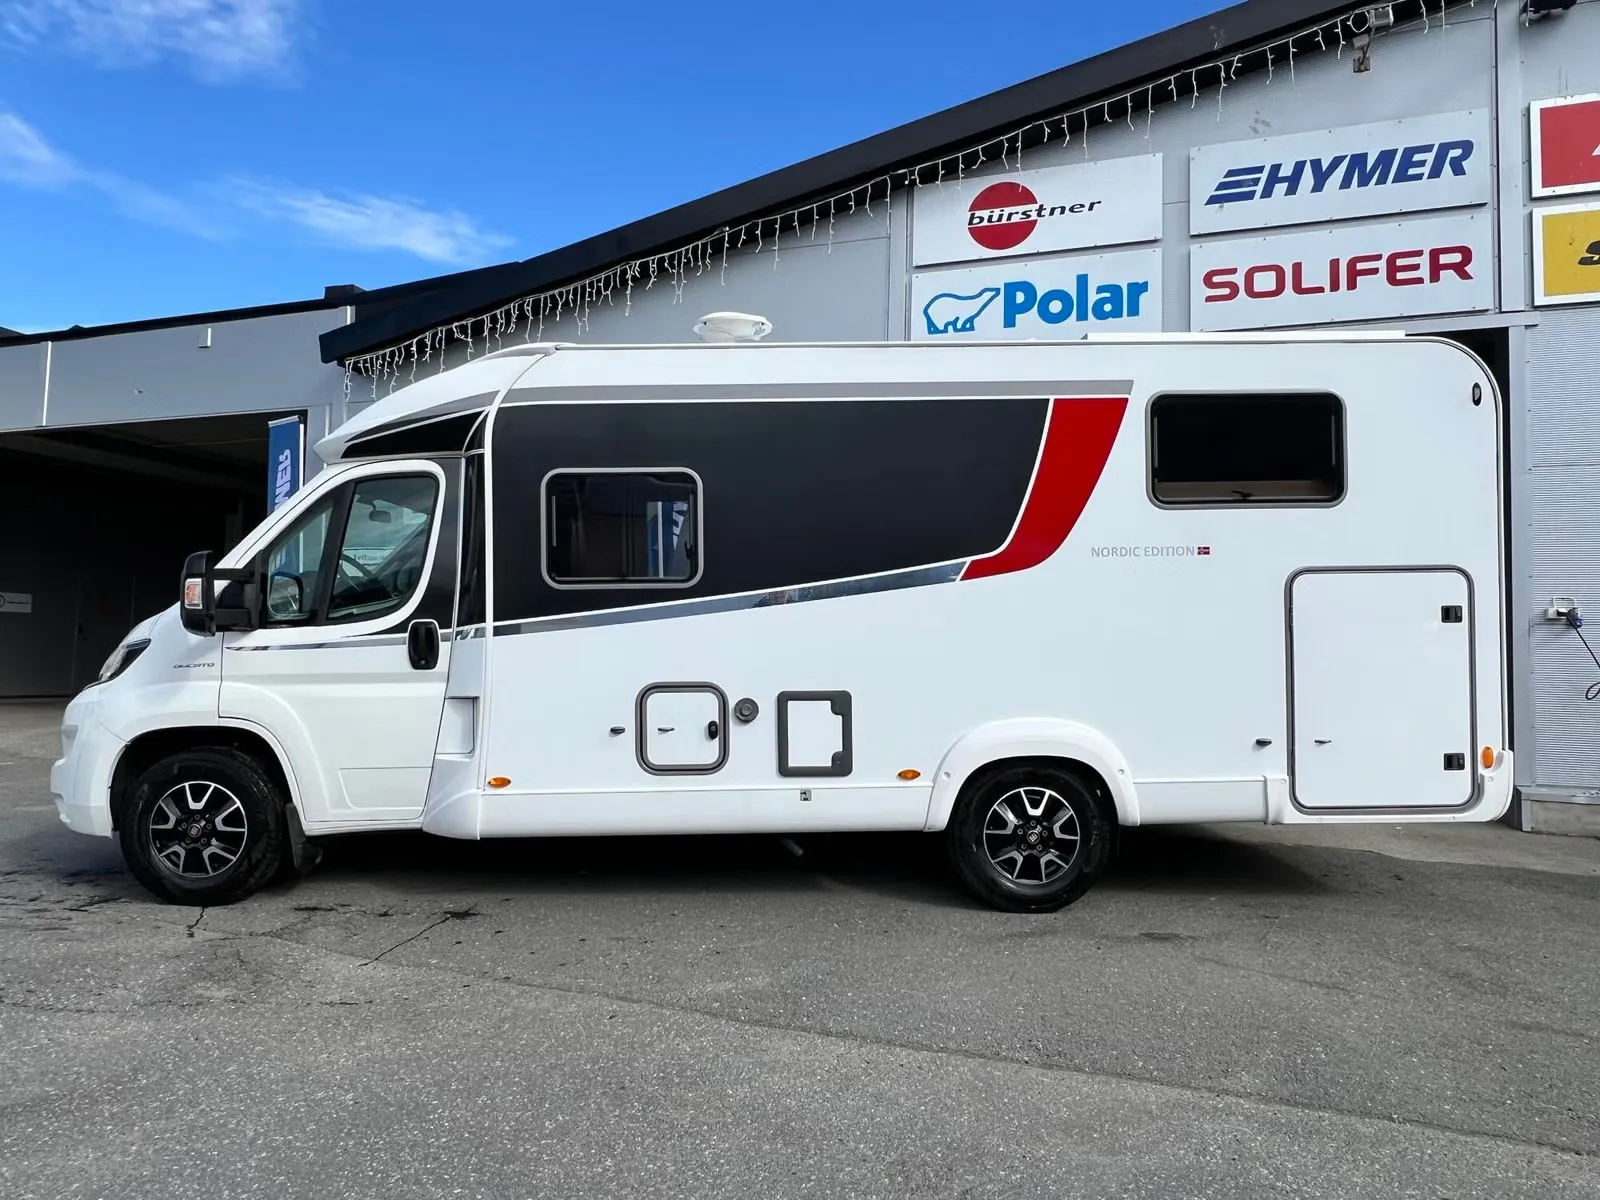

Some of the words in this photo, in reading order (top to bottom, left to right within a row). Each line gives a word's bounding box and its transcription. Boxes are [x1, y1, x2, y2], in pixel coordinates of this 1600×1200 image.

[1260, 139, 1474, 200] HYMER
[967, 200, 1102, 227] bürstner
[1003, 273, 1149, 329] Polar
[1202, 245, 1474, 303] SOLIFER
[1090, 546, 1141, 558] NORDIC
[1144, 545, 1195, 557] EDITION
